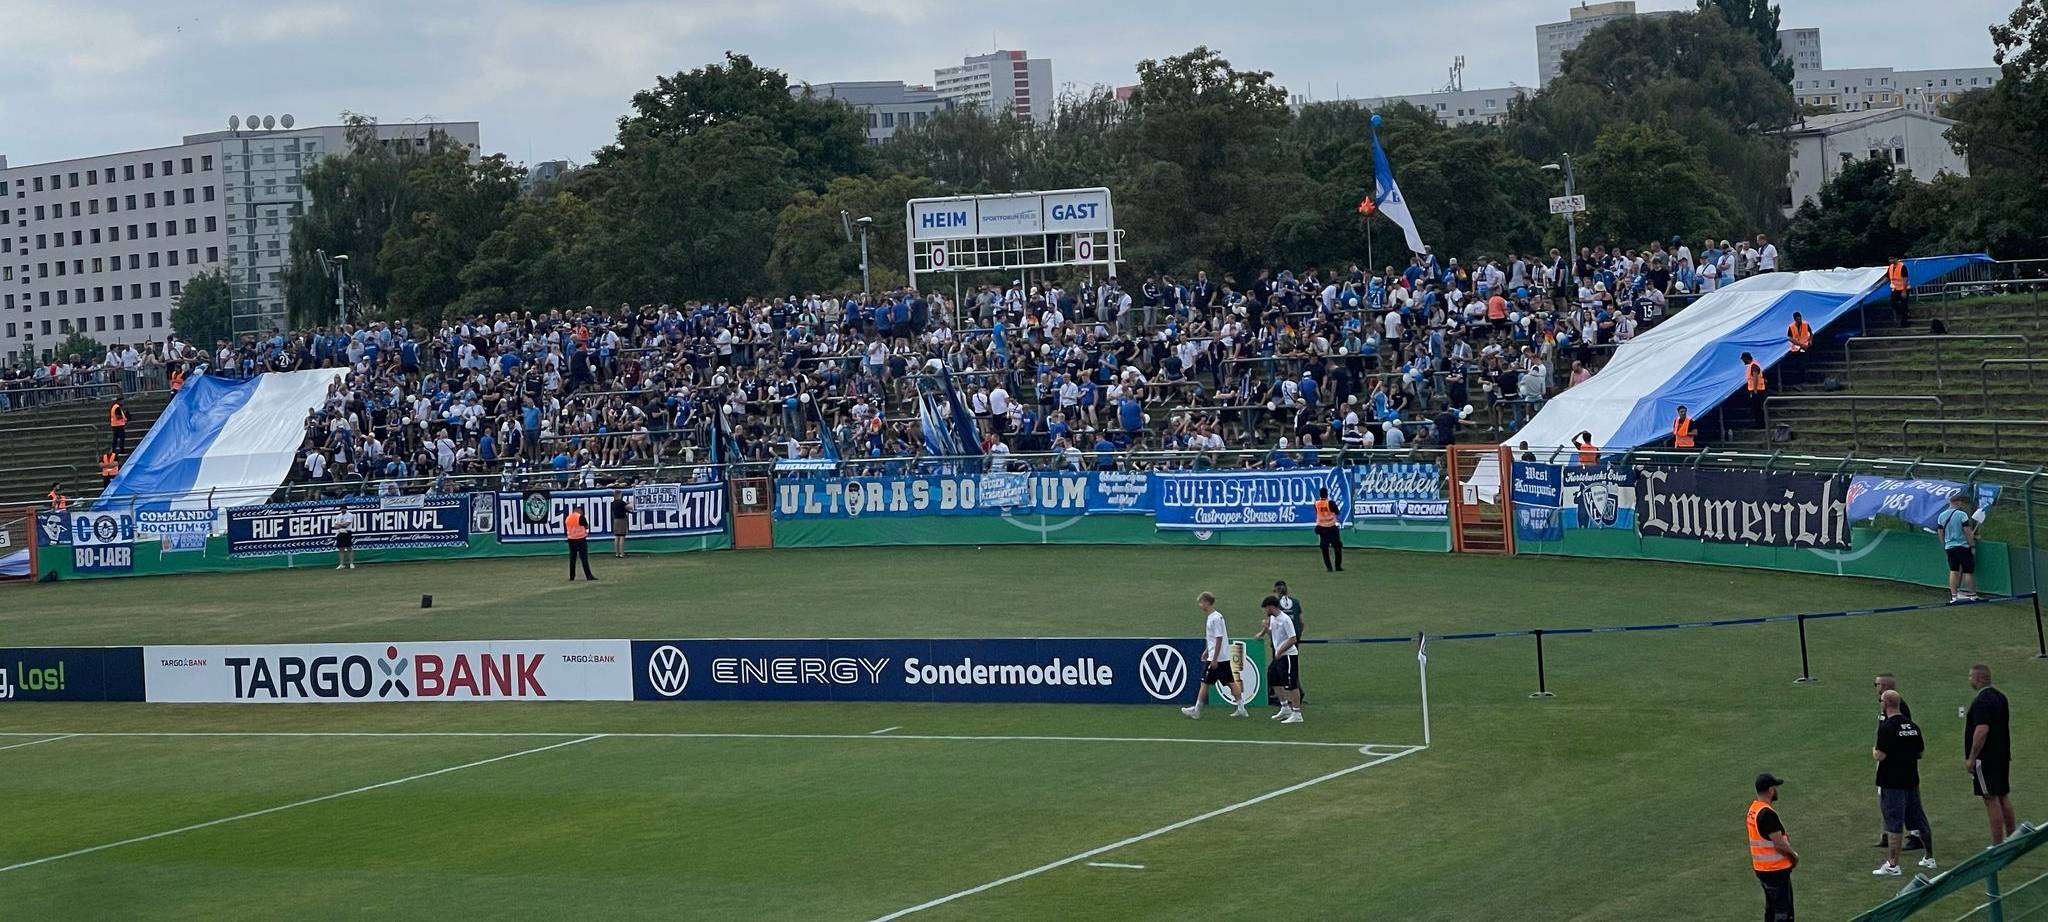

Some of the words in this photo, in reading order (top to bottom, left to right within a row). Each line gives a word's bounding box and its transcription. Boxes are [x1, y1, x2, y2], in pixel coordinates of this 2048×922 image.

[922, 211, 967, 228] HEIM
[1052, 203, 1098, 220] GAST
[933, 248, 944, 266] 0
[1079, 240, 1091, 259] 0
[1643, 305, 1653, 318] 15
[1357, 465, 1438, 495] Alstaden
[1525, 467, 1548, 480] West
[746, 491, 752, 501] 6
[940, 476, 1087, 510] BOUM
[1164, 477, 1323, 507] RUHRSTADION
[1467, 489, 1473, 500] 7
[1514, 479, 1556, 497] Kompanie
[140, 510, 214, 522] COMMANDO
[622, 489, 723, 531] OLLEKTIV
[1243, 507, 1277, 523] Strasse
[1354, 503, 1392, 514] SEKTION
[1408, 503, 1447, 515] BOCHUM
[1641, 469, 1847, 546] Emmerich
[252, 518, 284, 538] AUF
[372, 511, 408, 531] MEIN
[412, 510, 444, 530] VFL
[76, 547, 132, 567] BO-LAER
[18, 661, 65, 690] los!
[712, 658, 890, 684] ENERGY
[904, 657, 1113, 686] Sondermodelle
